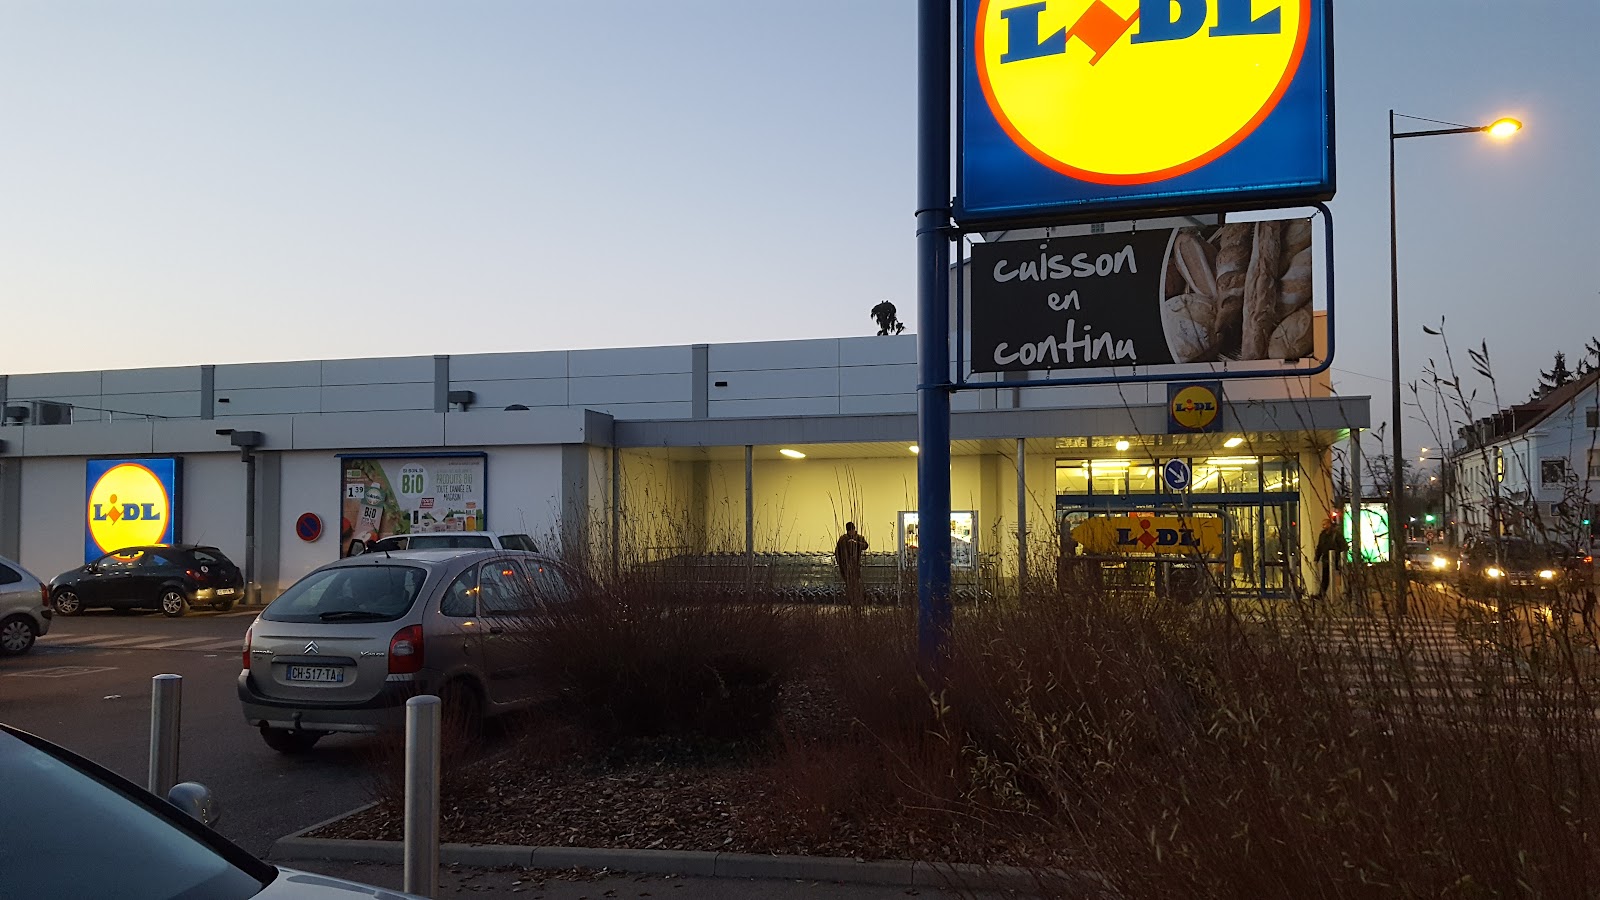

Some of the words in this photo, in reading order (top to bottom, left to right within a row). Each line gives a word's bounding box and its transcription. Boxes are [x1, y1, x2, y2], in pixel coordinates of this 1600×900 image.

[993, 244, 1137, 282] cuisson
[1048, 290, 1080, 311] en
[993, 318, 1137, 366] continu
